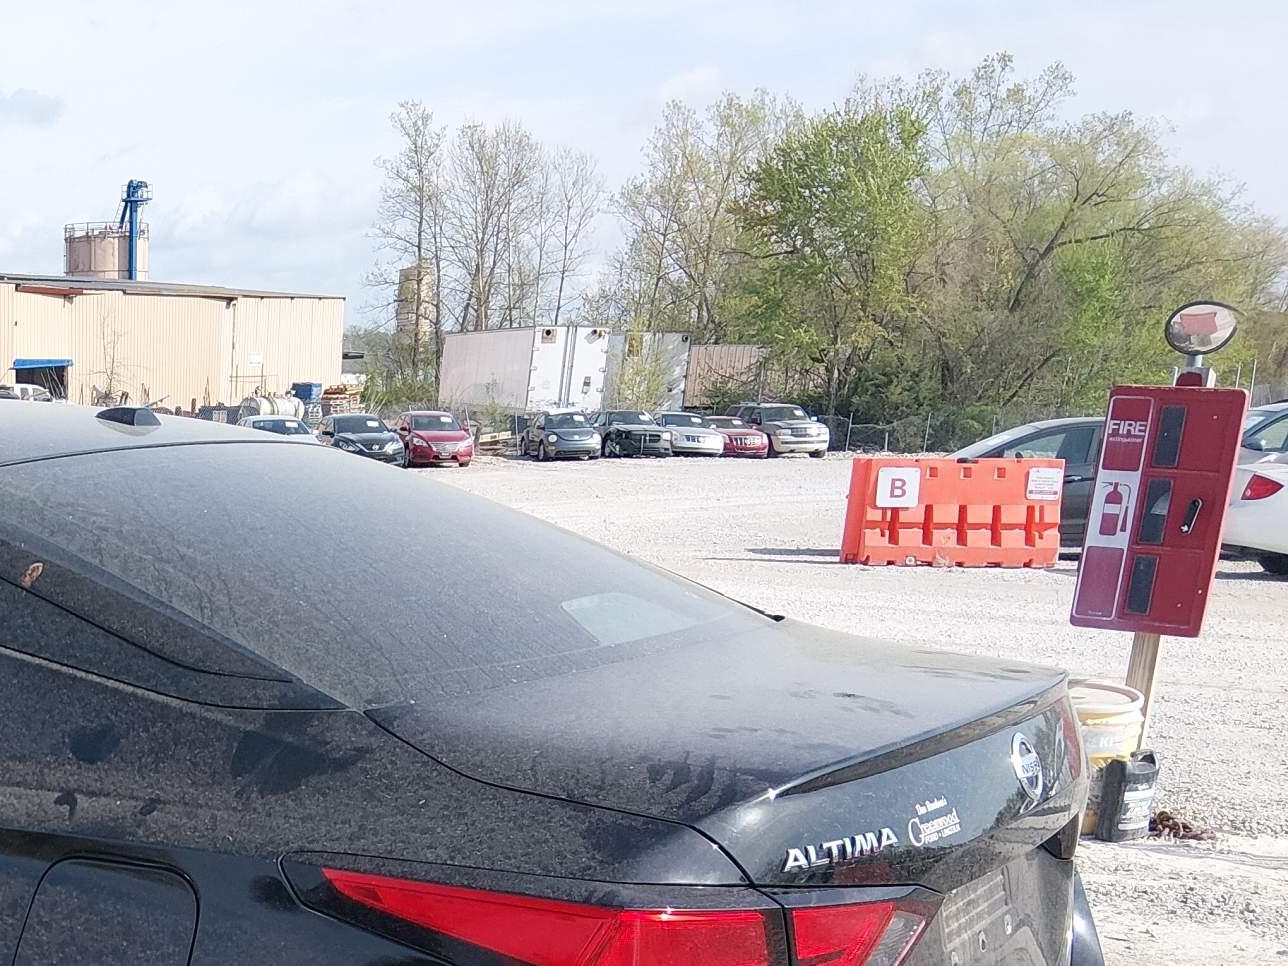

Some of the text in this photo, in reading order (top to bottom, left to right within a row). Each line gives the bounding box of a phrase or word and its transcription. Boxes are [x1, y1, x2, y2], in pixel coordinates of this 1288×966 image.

[1108, 420, 1148, 435] FIRE
[889, 478, 907, 498] B
[908, 807, 960, 846] Greenwood
[782, 827, 899, 873] ALTIMA
